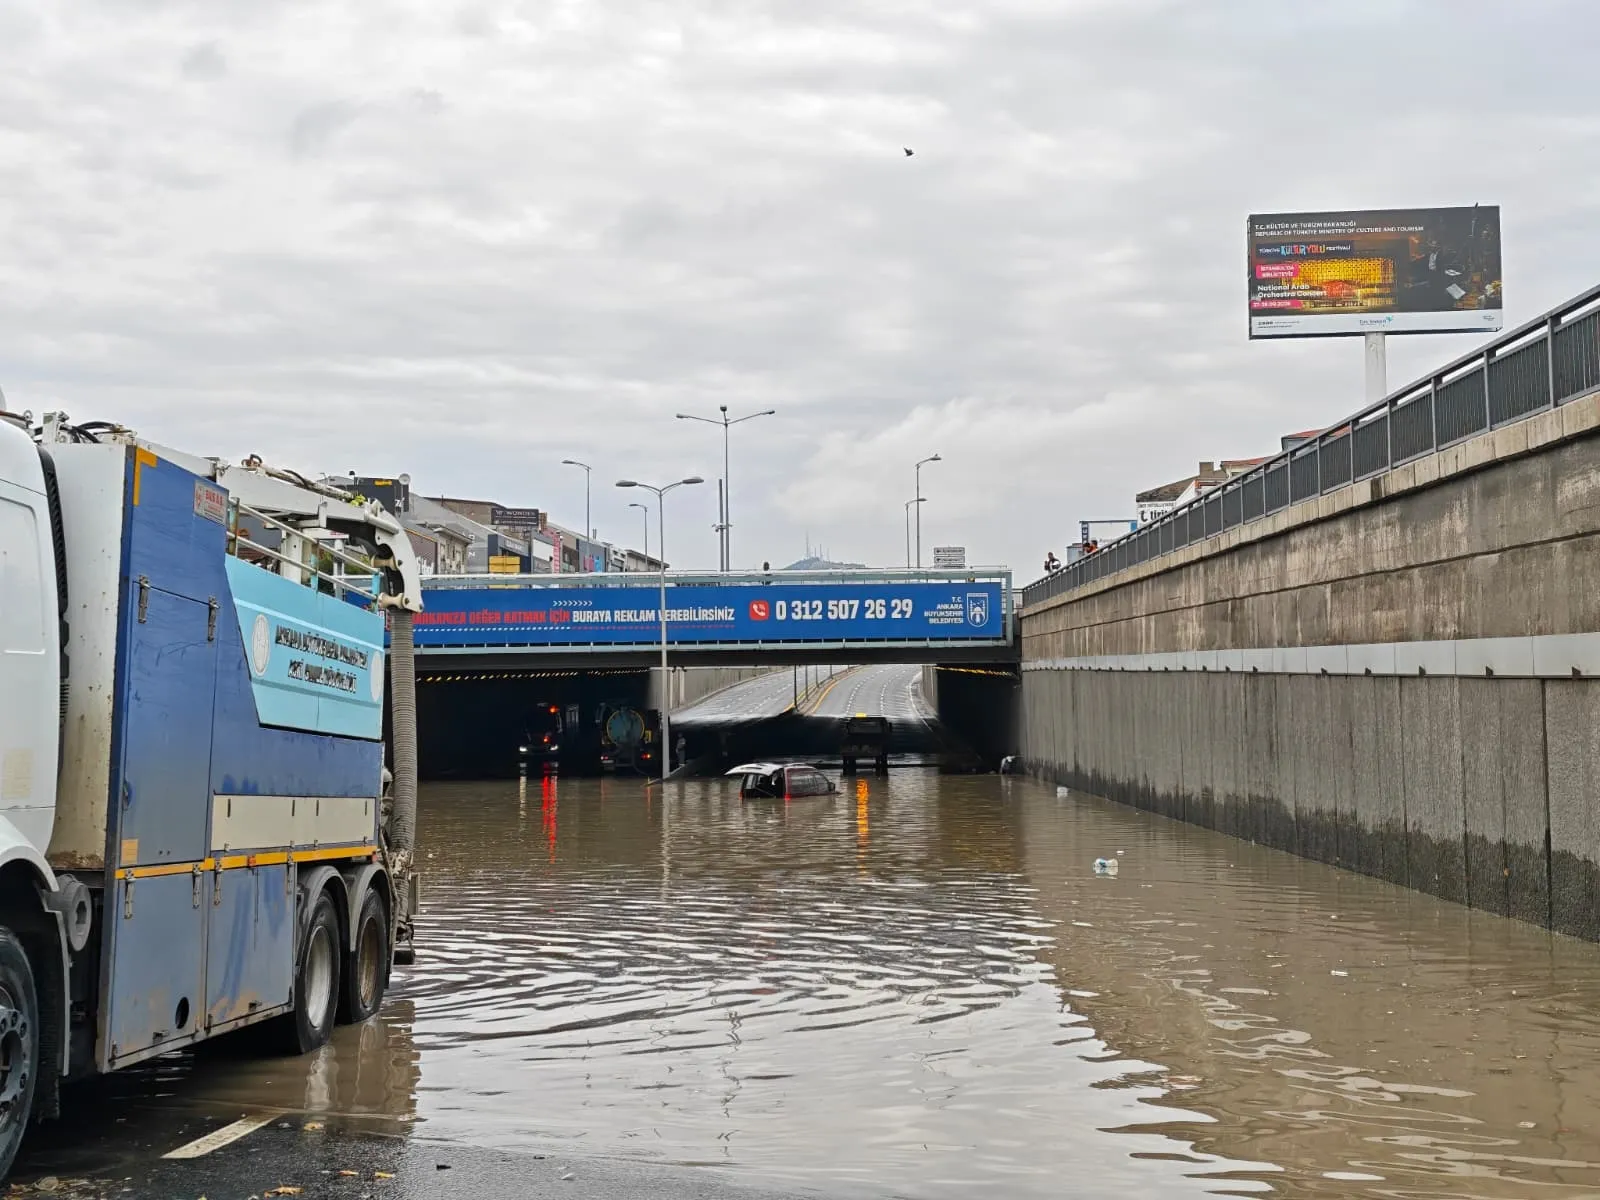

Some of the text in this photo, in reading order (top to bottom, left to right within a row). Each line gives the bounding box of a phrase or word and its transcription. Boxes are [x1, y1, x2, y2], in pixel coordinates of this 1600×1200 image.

[504, 610, 546, 623] KATMAK
[550, 608, 570, 623] İÇİN
[572, 610, 611, 622] BURAYA
[614, 610, 655, 622] REKLAM
[658, 606, 735, 621] VEREBİLİRSİNİZ
[775, 599, 913, 620] 0 312 507 26 29
